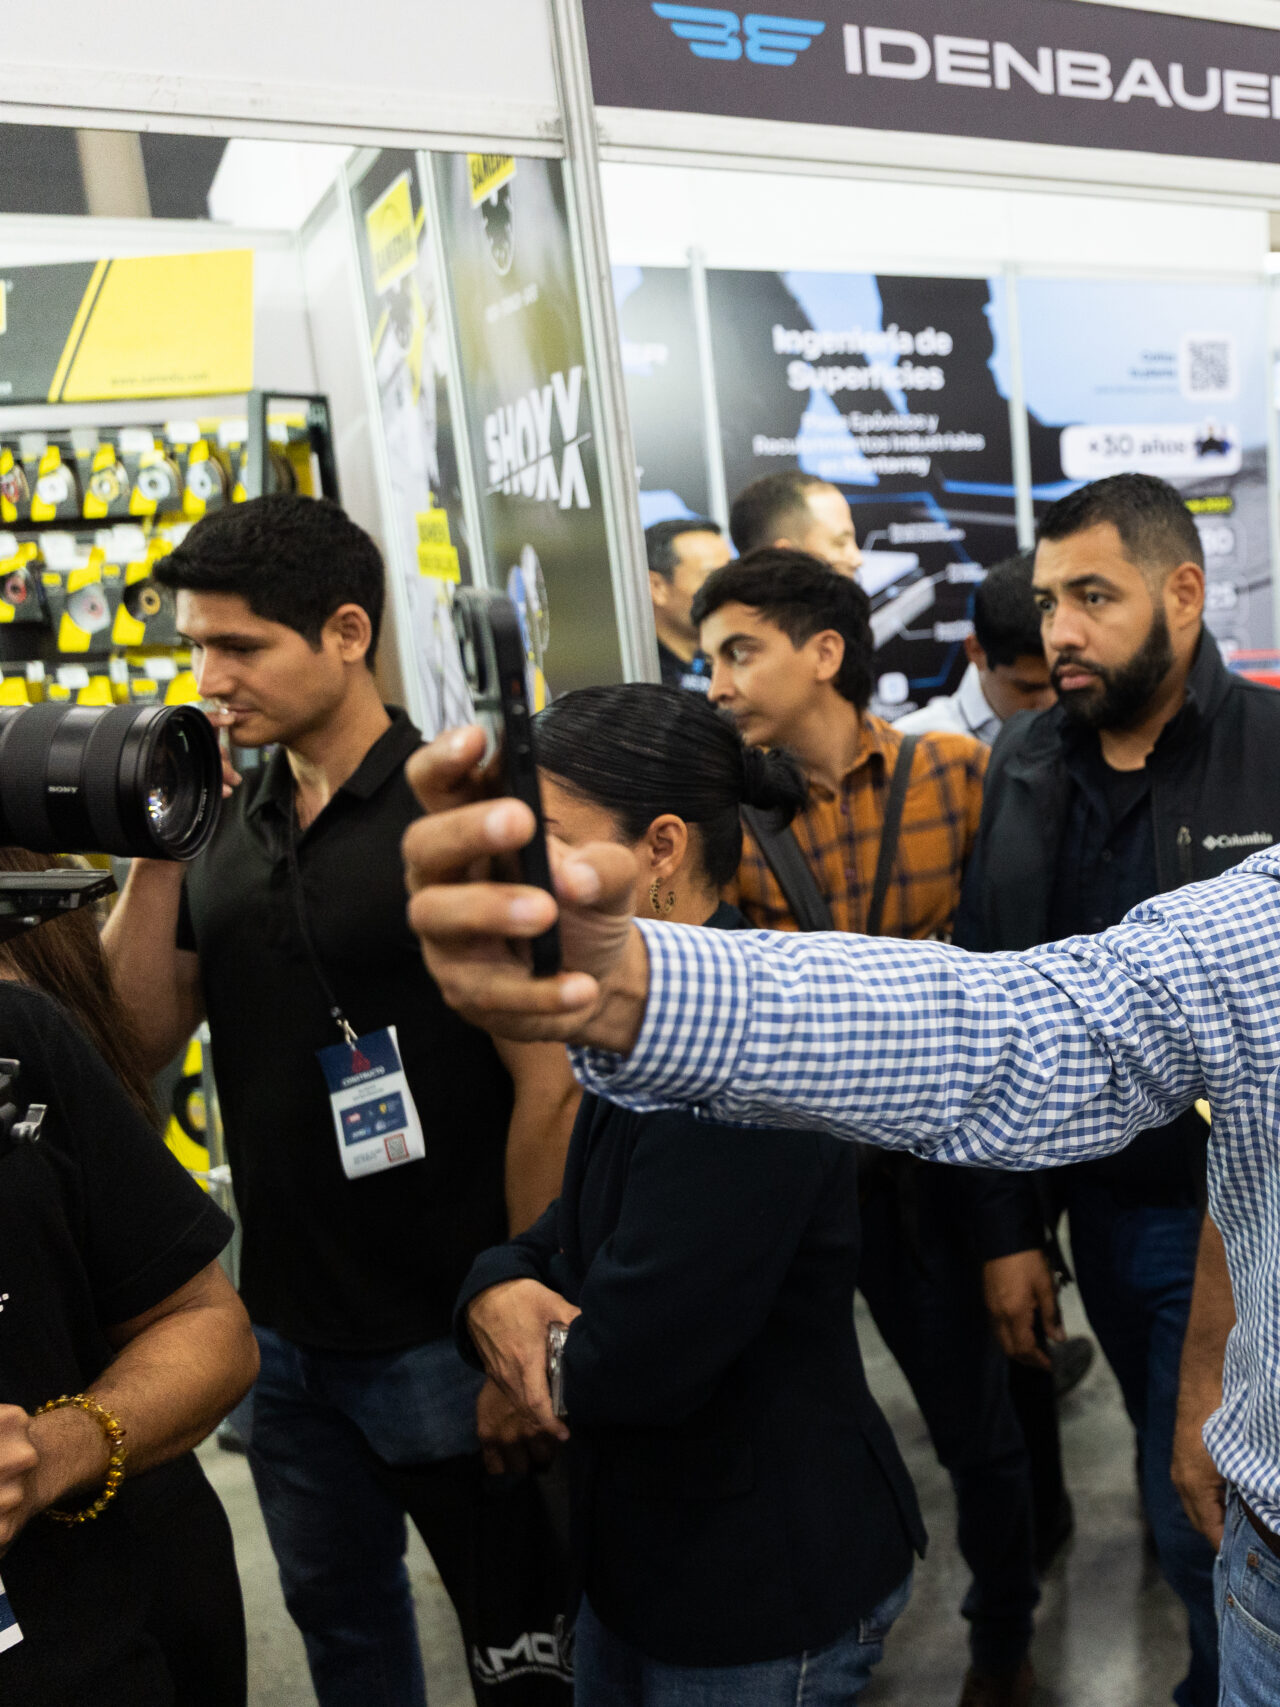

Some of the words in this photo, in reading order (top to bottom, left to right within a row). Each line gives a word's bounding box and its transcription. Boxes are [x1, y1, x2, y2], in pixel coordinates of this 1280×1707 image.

[915, 326, 953, 356] de
[787, 360, 945, 395] Superficies
[48, 785, 78, 794] SONY
[1216, 831, 1273, 849] Columbia
